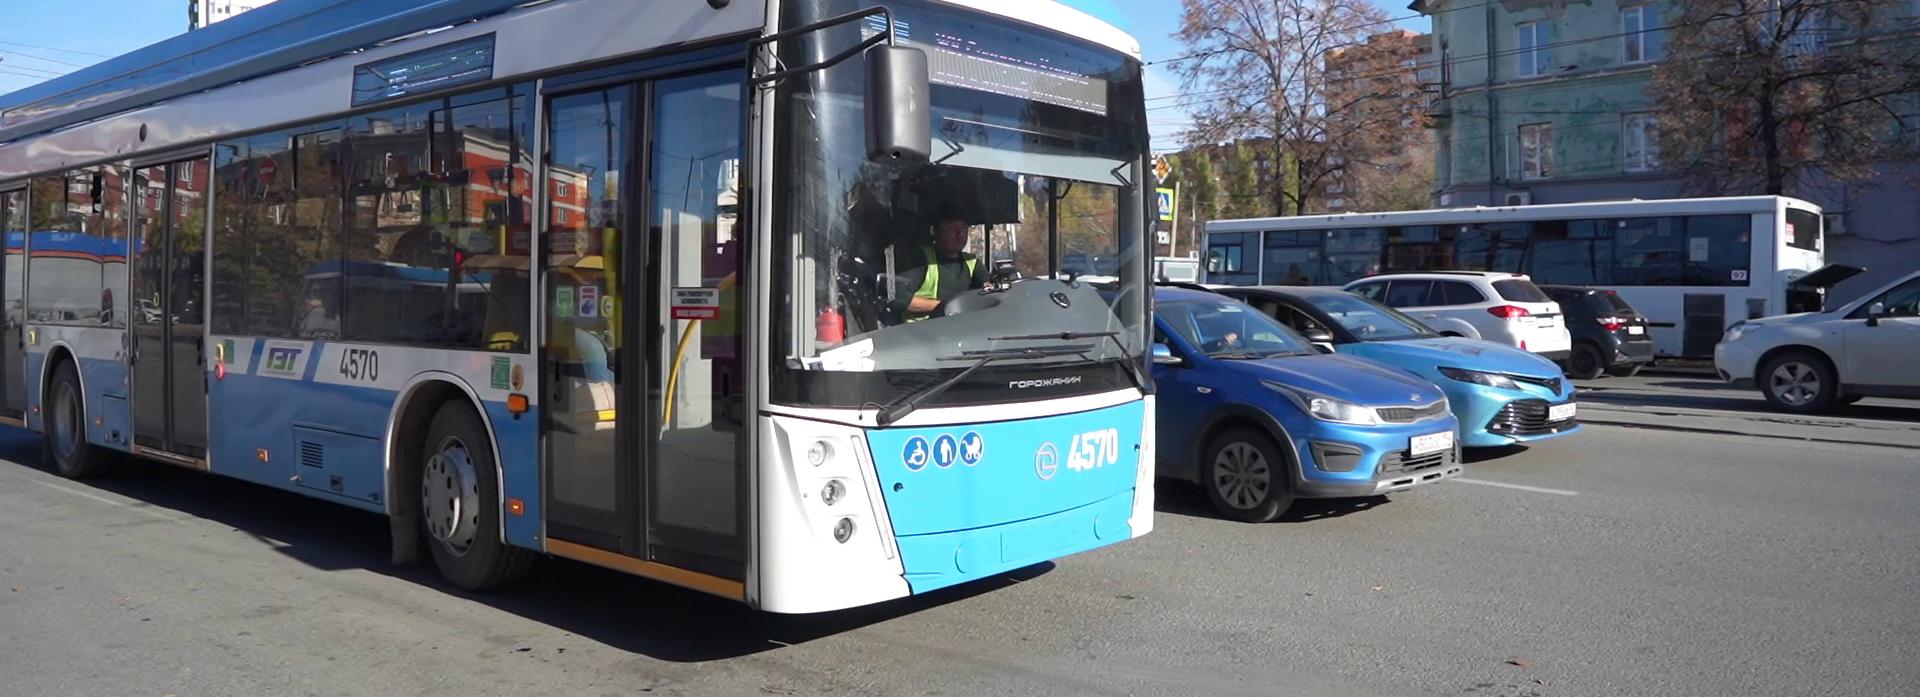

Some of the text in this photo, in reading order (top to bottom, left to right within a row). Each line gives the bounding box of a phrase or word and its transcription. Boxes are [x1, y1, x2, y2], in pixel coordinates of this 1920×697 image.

[339, 348, 379, 381] 4570
[1009, 376, 1081, 389] ГОРОЖАНИН
[1066, 428, 1118, 472] 4570
